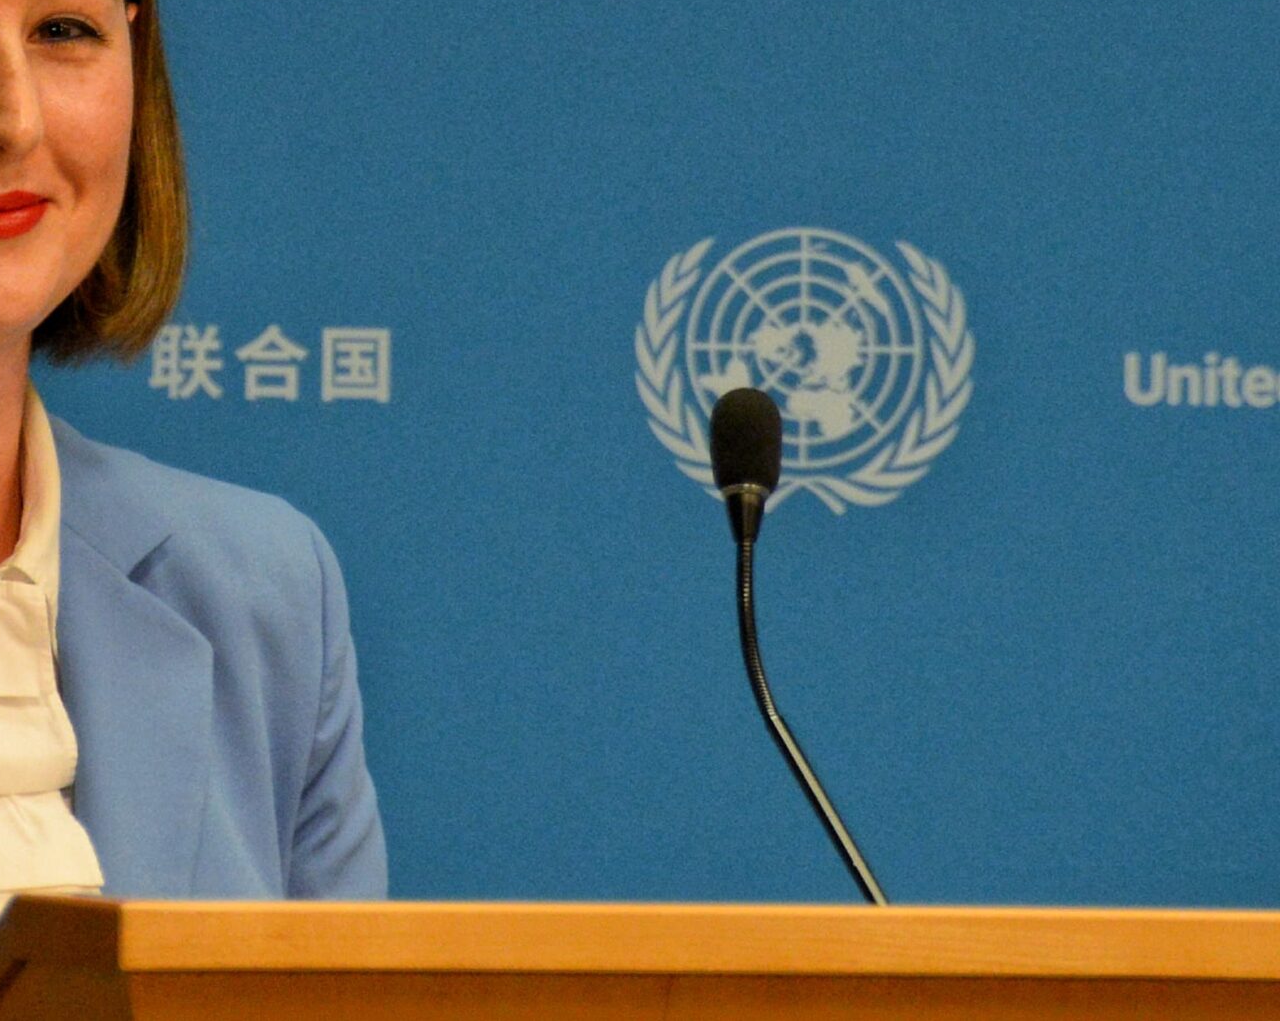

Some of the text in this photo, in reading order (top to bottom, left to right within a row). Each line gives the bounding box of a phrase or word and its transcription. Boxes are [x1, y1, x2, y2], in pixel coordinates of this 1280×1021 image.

[148, 323, 391, 403] 联合国
[1123, 352, 1280, 409] Unite
